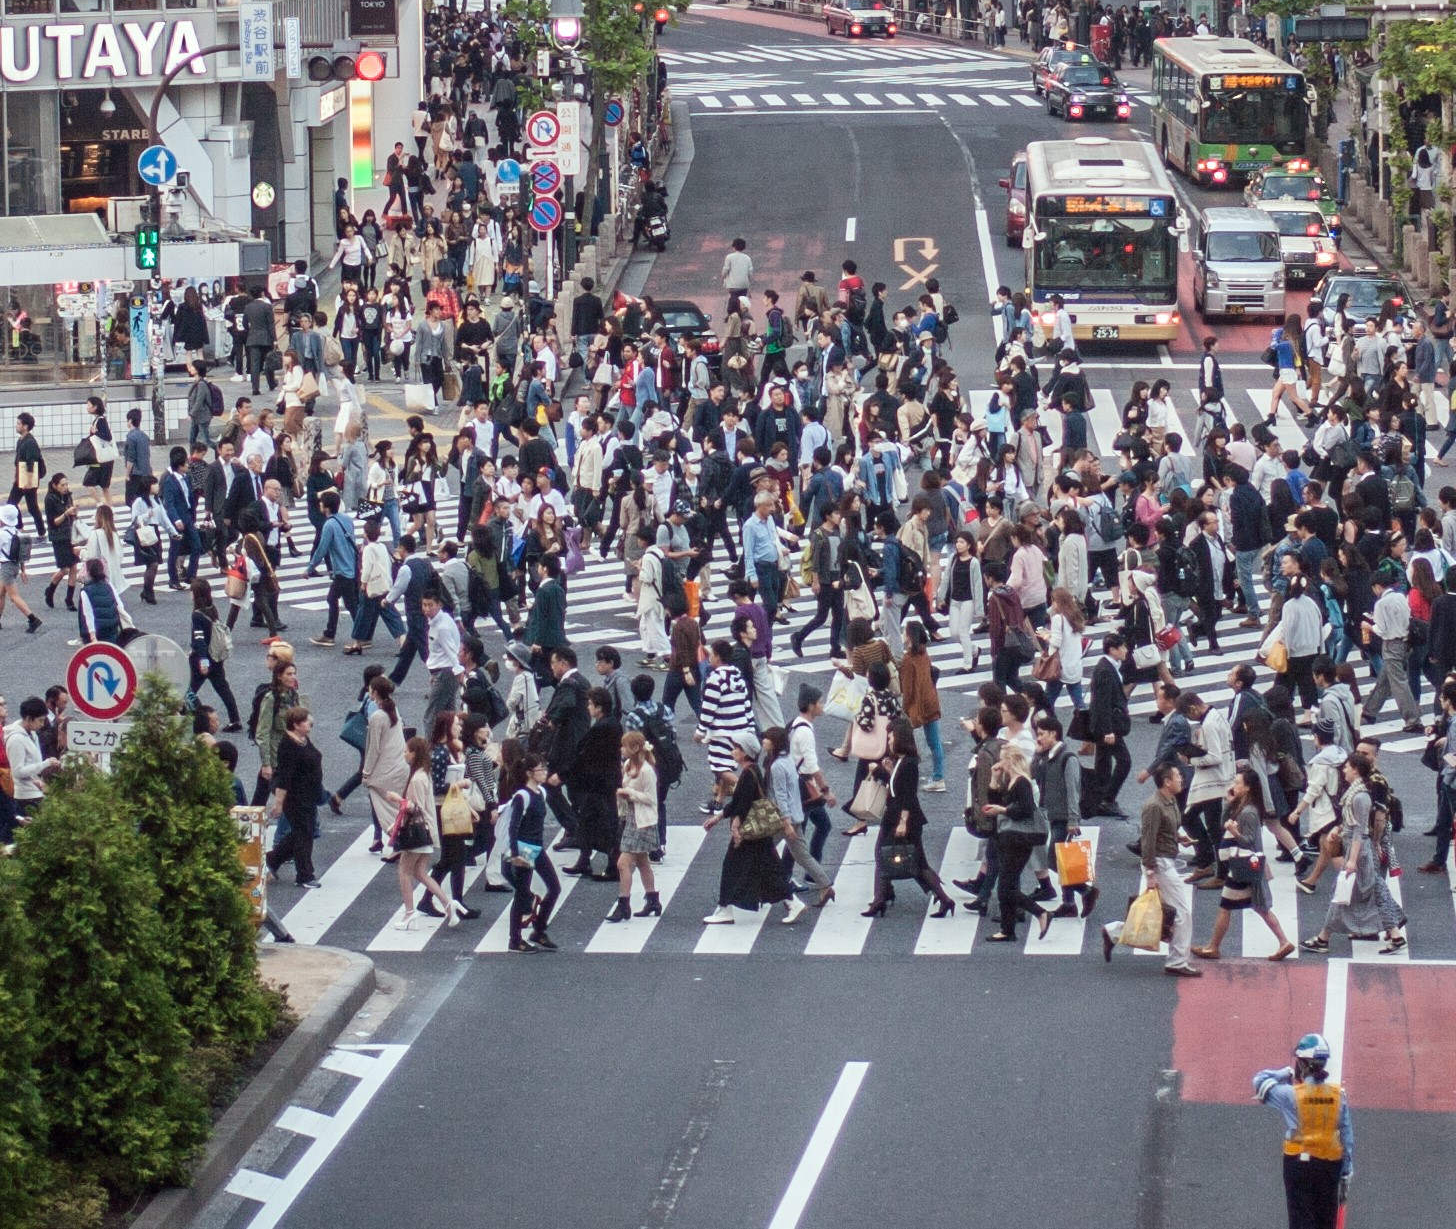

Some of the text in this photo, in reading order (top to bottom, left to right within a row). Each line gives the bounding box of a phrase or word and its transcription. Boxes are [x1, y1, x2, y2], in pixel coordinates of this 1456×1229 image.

[360, 0, 386, 9] TOKYO
[253, 8, 269, 75] 渋谷駅前
[560, 106, 573, 168] 公園通り
